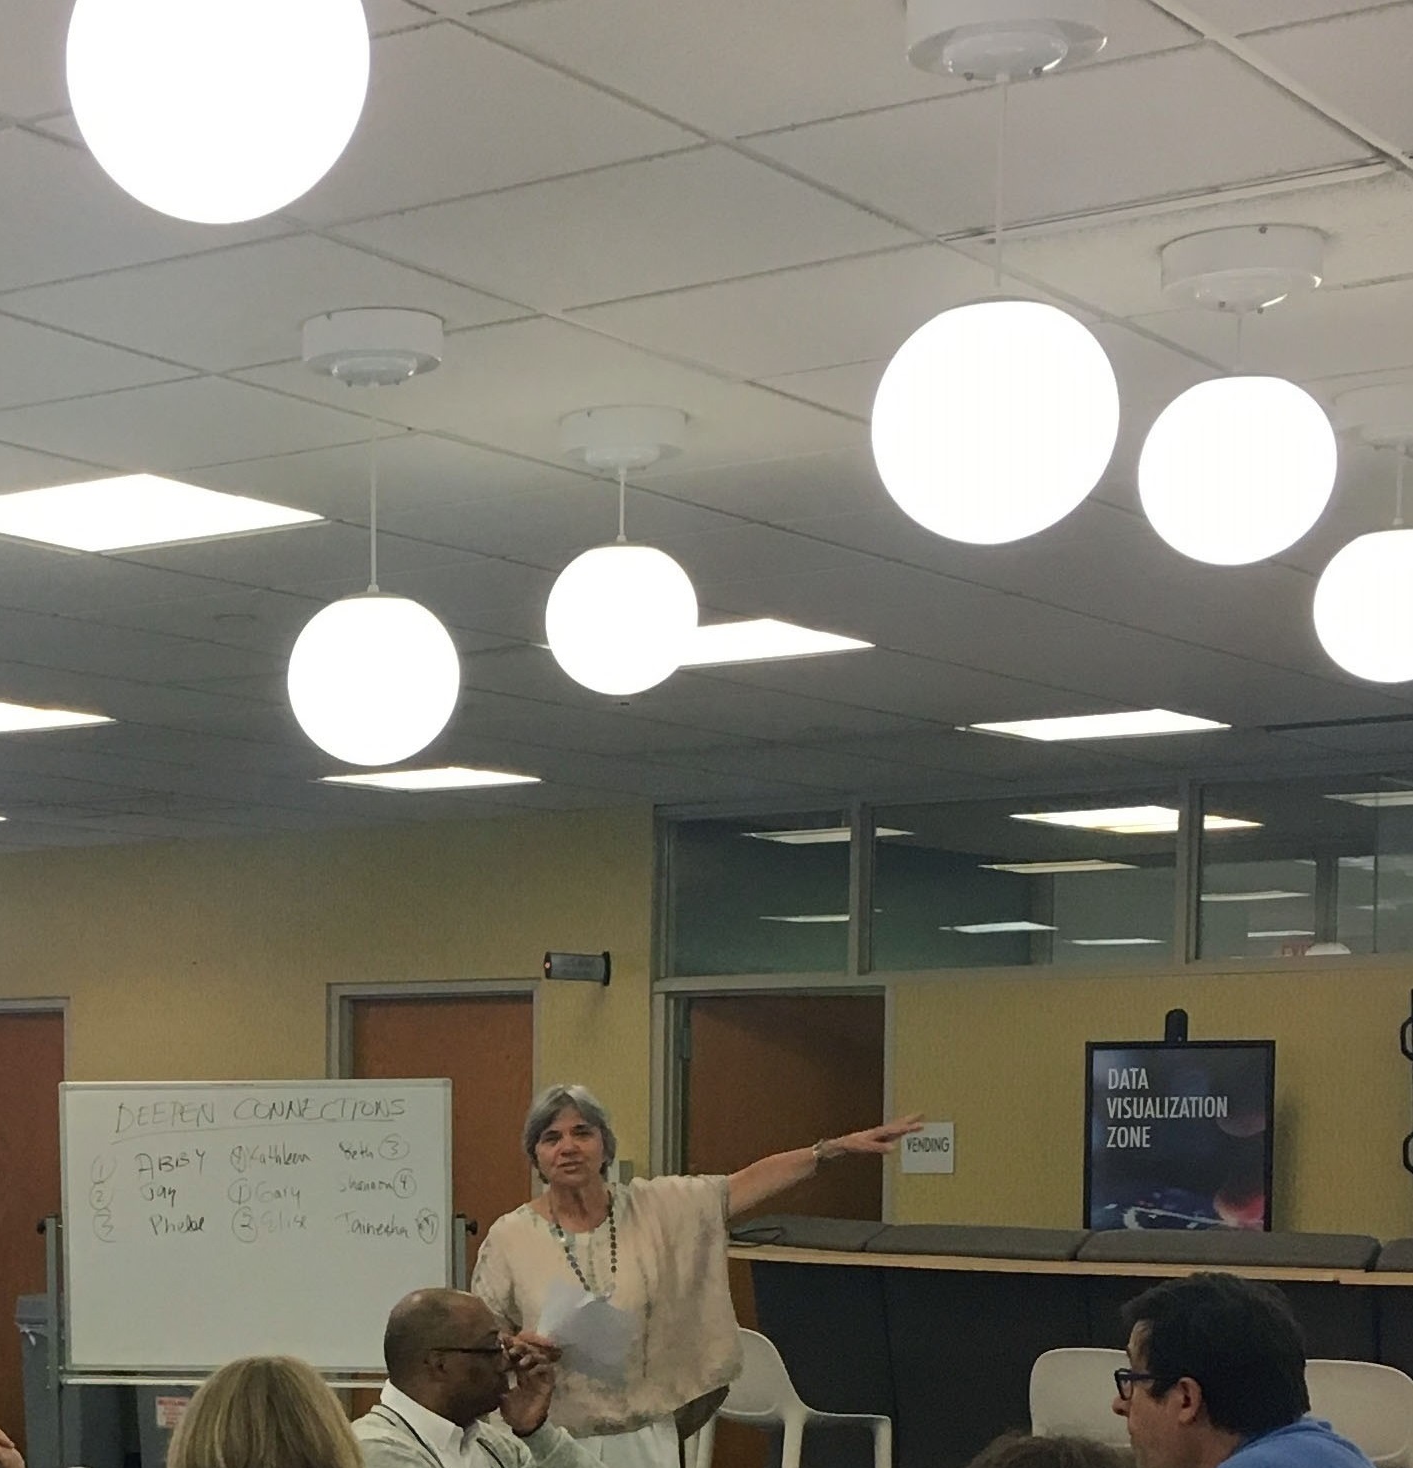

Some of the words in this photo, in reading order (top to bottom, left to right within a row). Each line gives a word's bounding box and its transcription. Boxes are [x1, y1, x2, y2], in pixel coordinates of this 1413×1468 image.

[1108, 1068, 1150, 1090] DATA
[115, 1102, 215, 1134] DEEPEN
[233, 1098, 406, 1122] CONNECTIONS
[1106, 1096, 1229, 1119] VISUALIZATION
[906, 1136, 950, 1153] VENDING
[1106, 1126, 1152, 1149] ZONE
